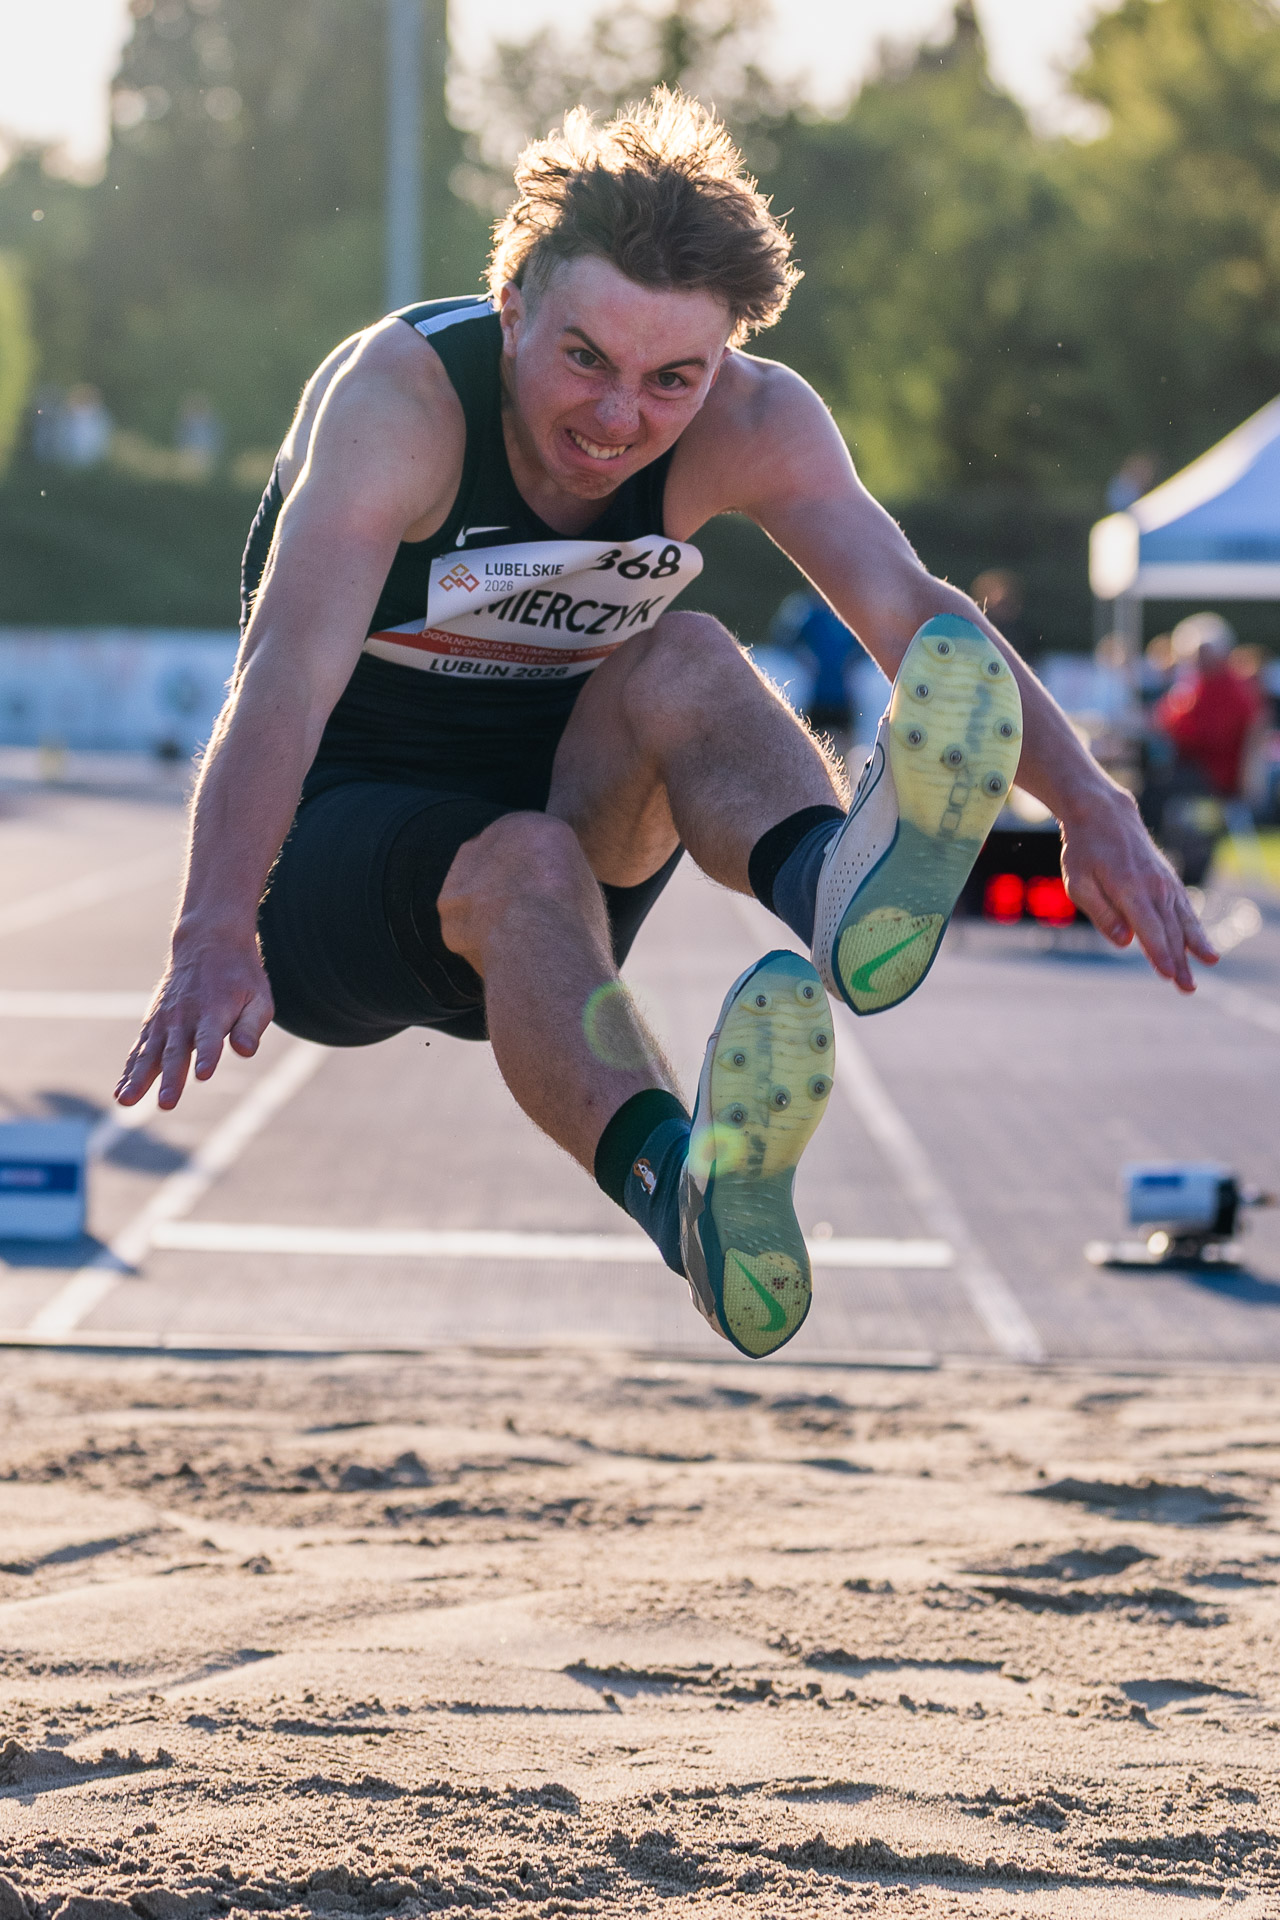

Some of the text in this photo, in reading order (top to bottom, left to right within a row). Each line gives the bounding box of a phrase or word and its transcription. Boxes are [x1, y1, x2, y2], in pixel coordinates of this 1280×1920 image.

[485, 563, 564, 577] LUBELSKIE
[588, 544, 681, 579] 368
[484, 580, 514, 592] 2026
[421, 630, 512, 652] OGÓLNOPOLSKA
[449, 647, 461, 655] W
[463, 648, 522, 661] SPORTACH
[429, 658, 569, 678] LUBLIN 2026
